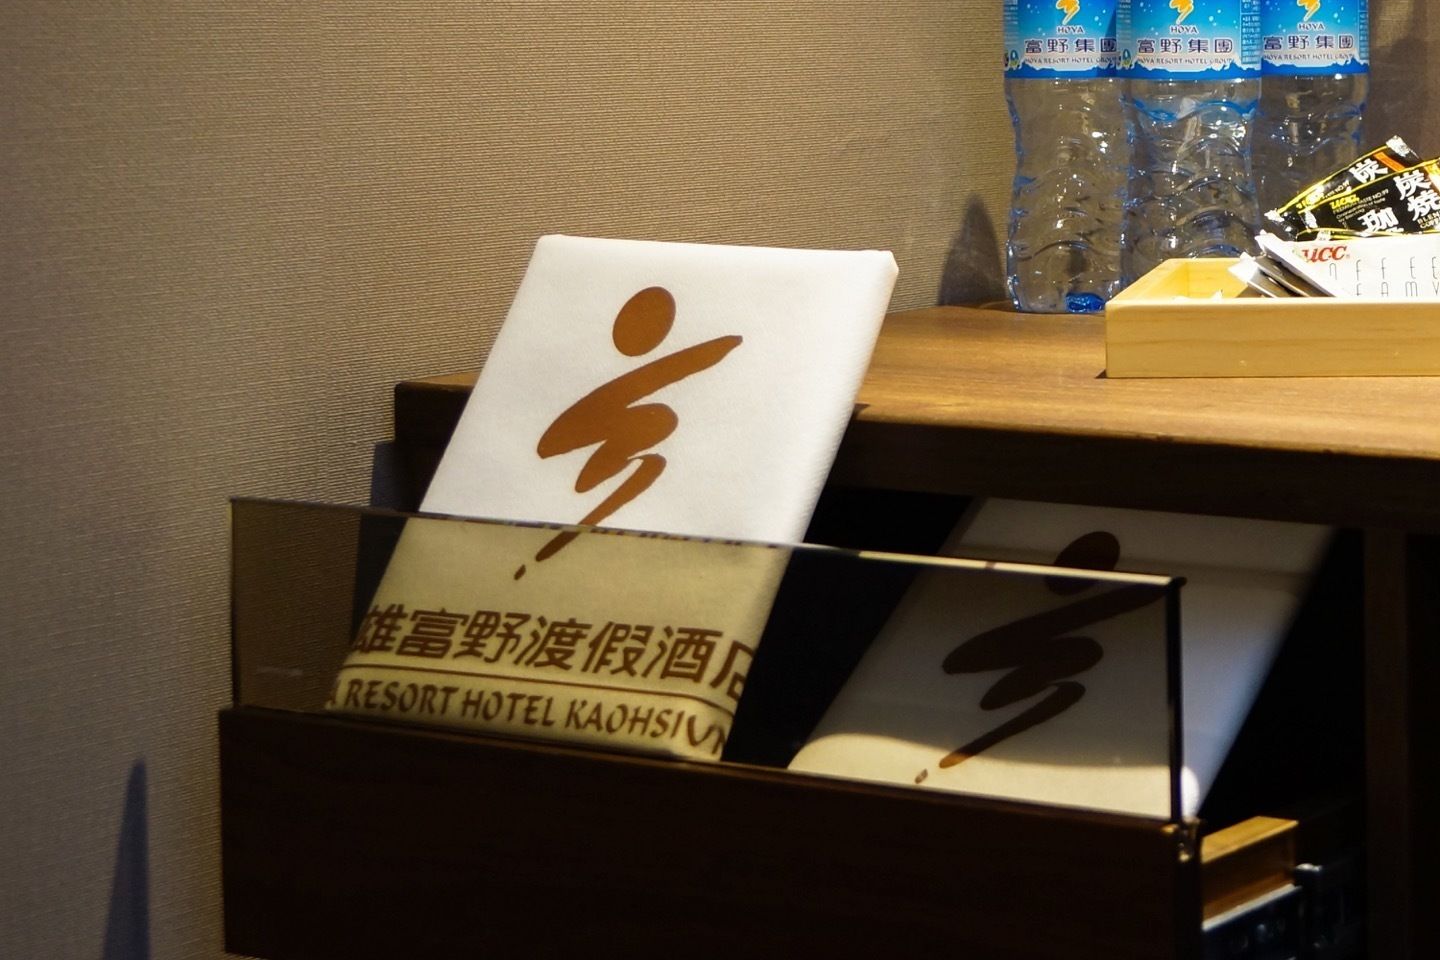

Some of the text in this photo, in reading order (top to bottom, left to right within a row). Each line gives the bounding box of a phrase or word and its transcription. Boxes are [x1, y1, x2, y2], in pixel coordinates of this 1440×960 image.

[1170, 25, 1198, 34] HOYA
[1024, 38, 1117, 54] 富野集團
[1137, 38, 1233, 54] 富野集團
[1263, 34, 1354, 50] 富野集團
[344, 678, 459, 716] RESORT
[461, 688, 556, 727] HOTEL
